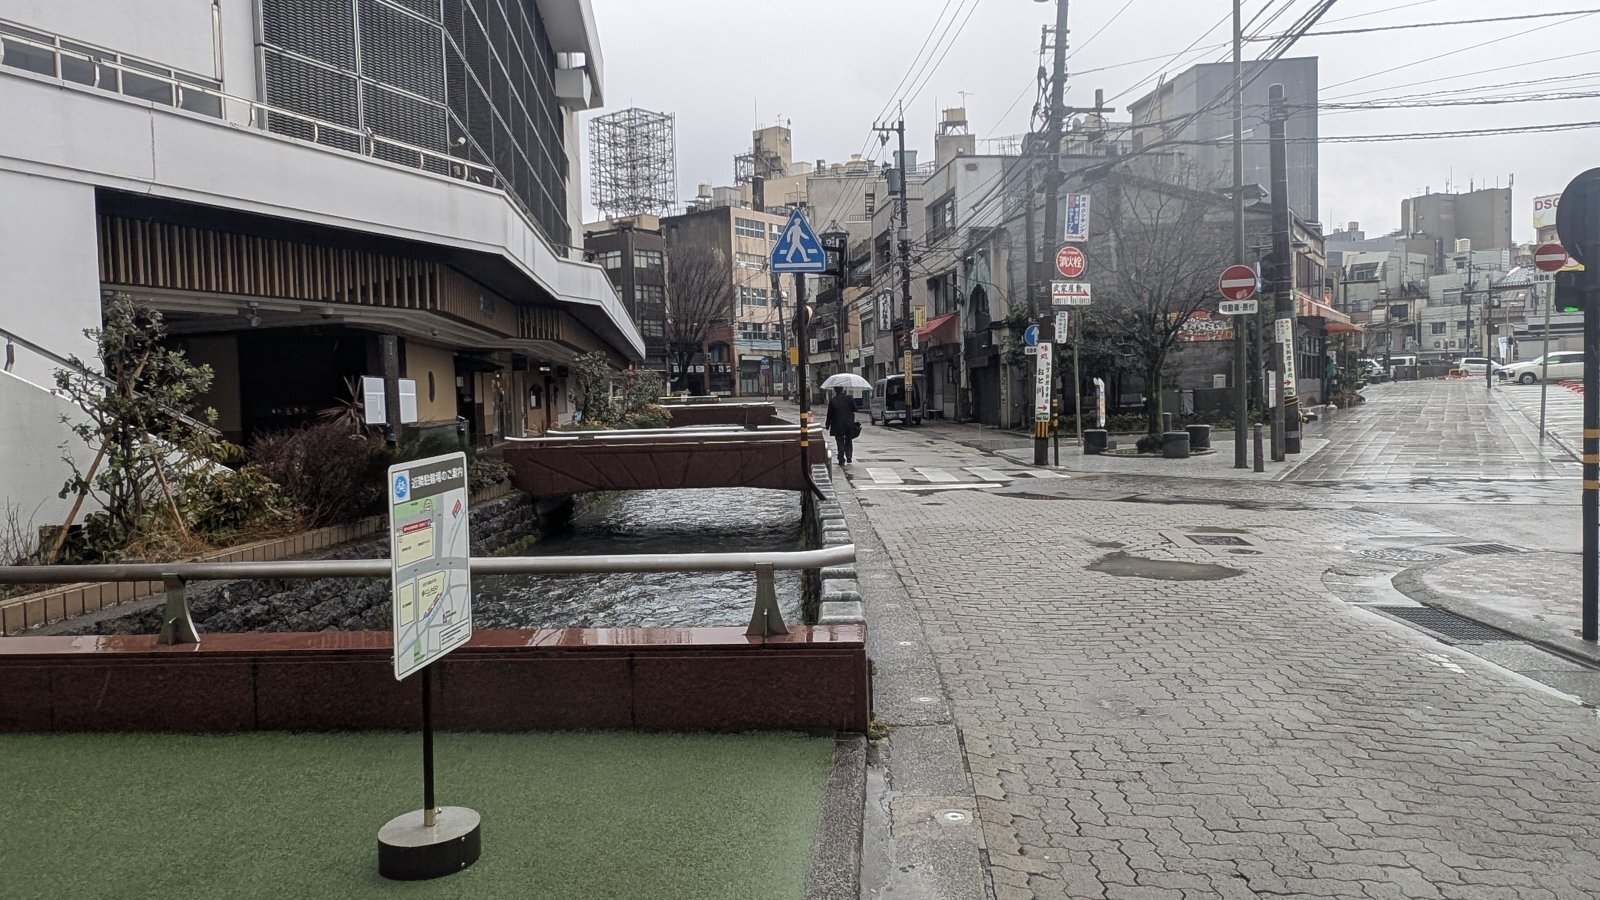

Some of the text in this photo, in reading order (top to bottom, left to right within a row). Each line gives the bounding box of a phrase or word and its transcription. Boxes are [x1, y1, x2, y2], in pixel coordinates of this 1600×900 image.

[1058, 256, 1083, 268] 消火栓
[1053, 284, 1083, 294] 武家屋敷
